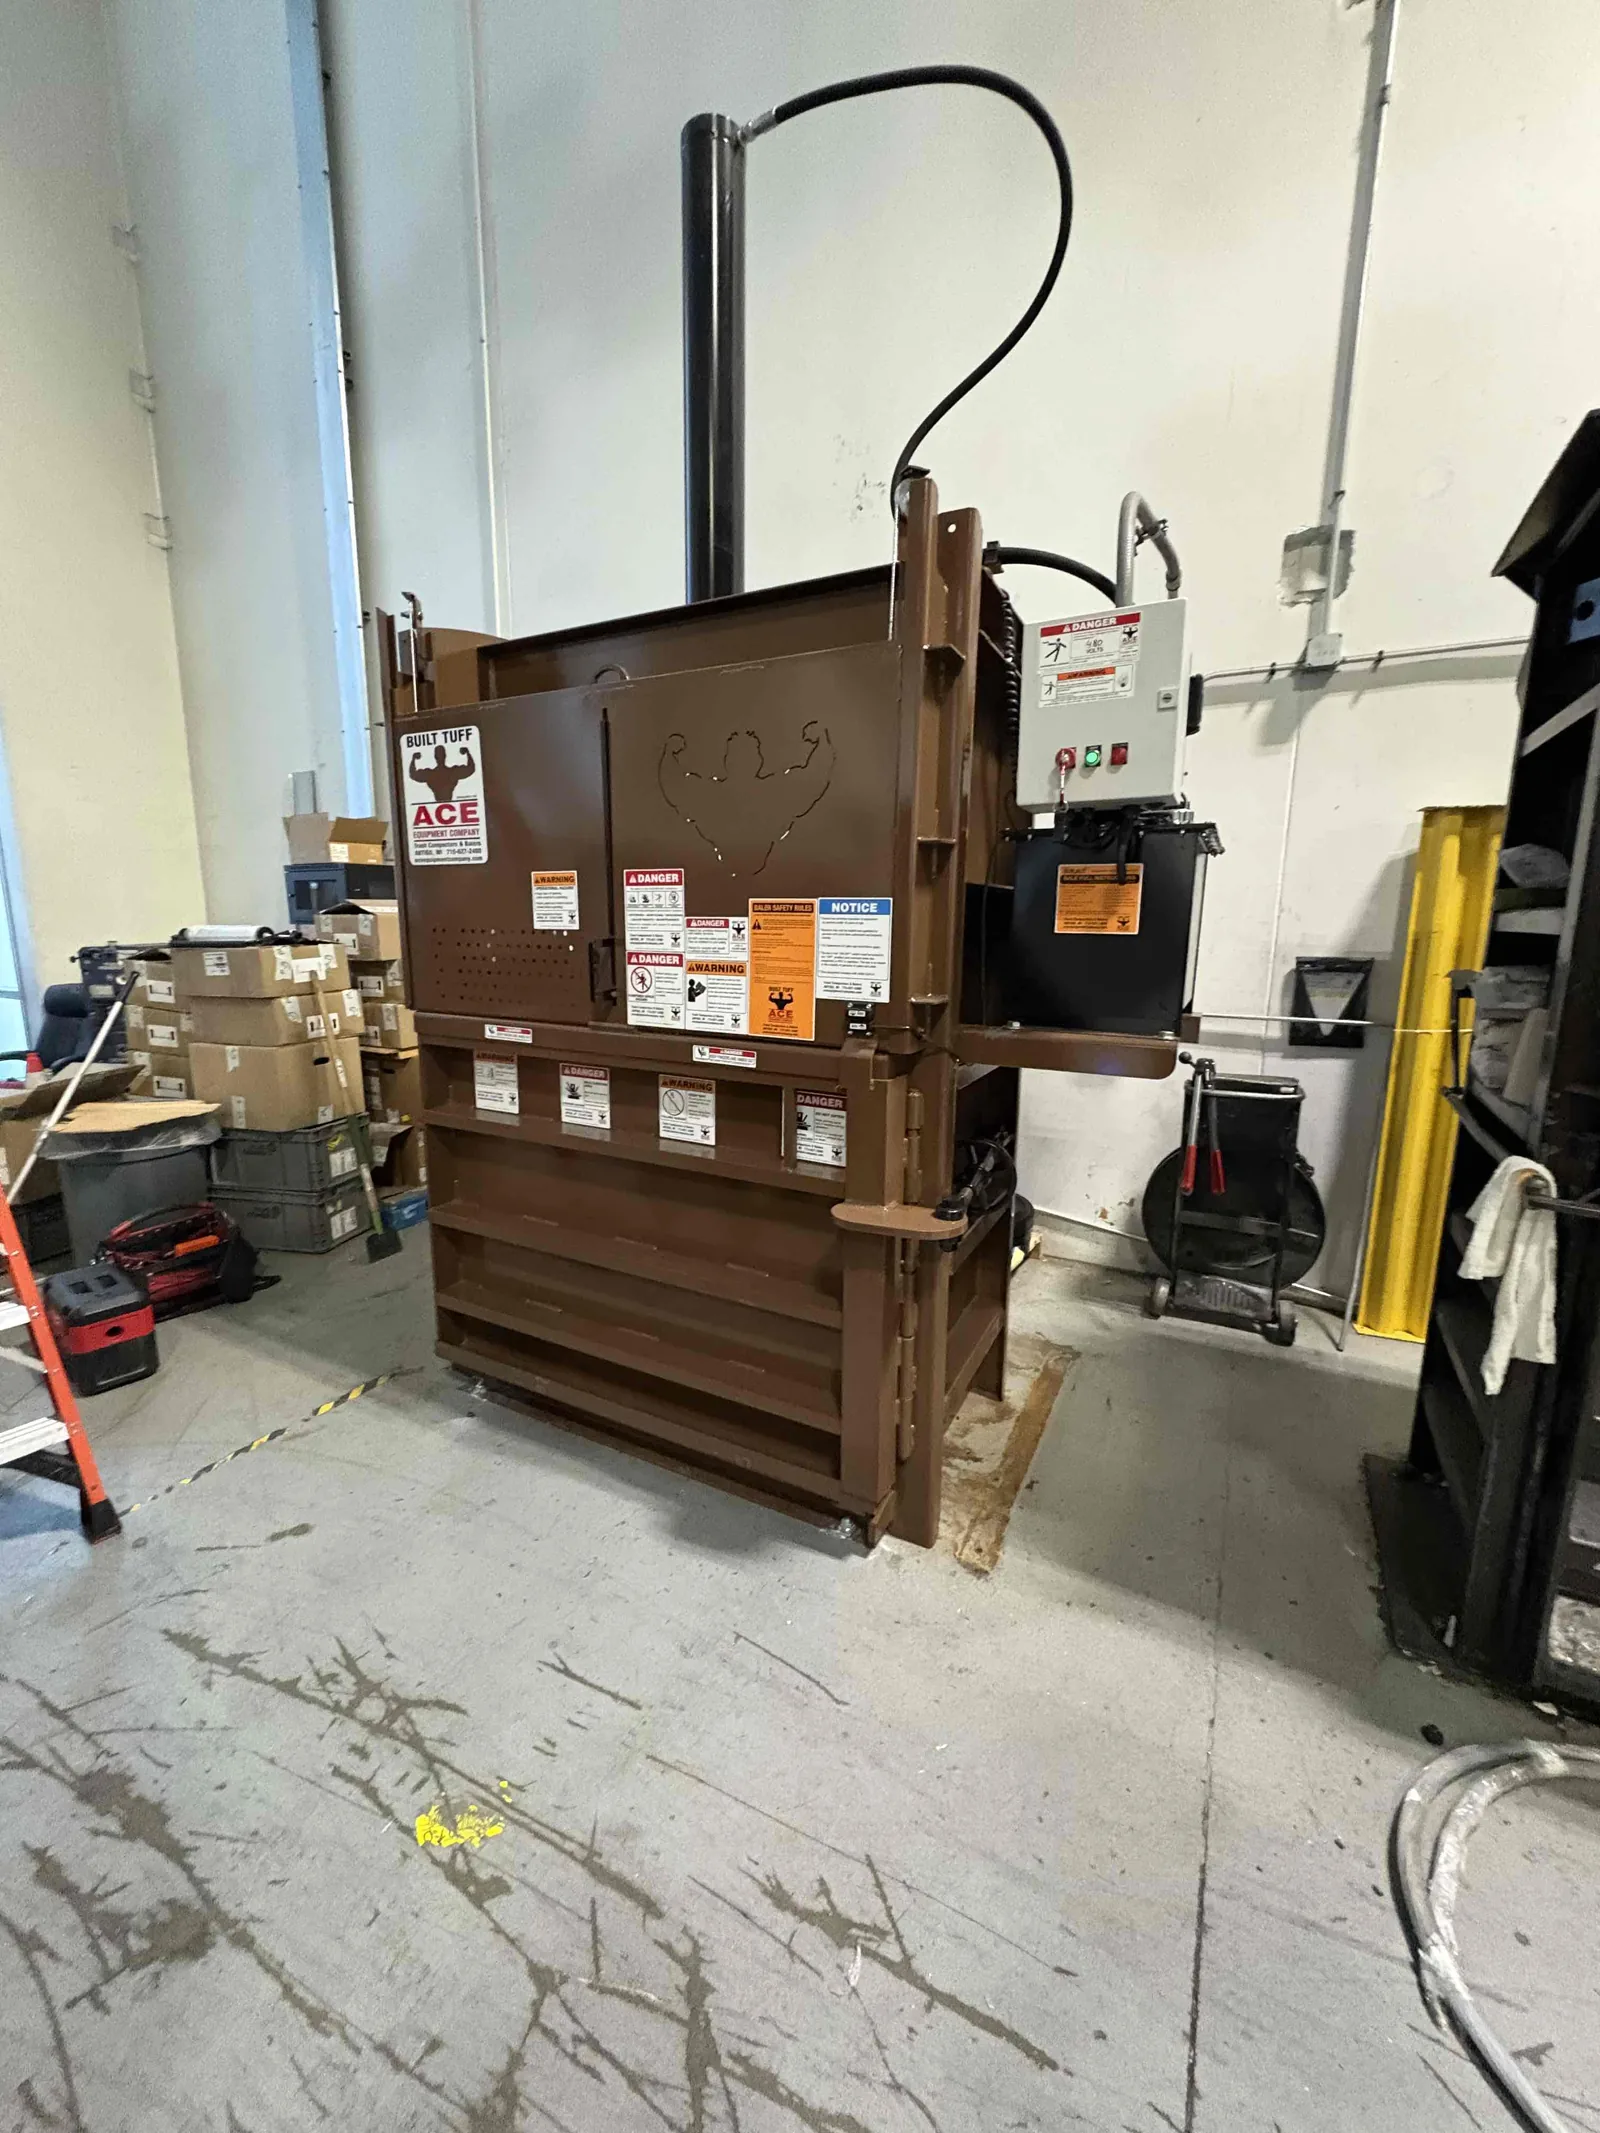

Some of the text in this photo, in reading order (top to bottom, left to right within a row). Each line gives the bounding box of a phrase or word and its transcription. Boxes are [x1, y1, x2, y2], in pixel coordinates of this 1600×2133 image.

[1072, 618, 1117, 631] DANGER
[406, 728, 473, 748] BUILT TUFF
[413, 802, 480, 826] ACE
[413, 828, 480, 839] EQUIPMENT COMPANY
[540, 875, 575, 883] WARNING
[637, 873, 679, 883] DANGER
[831, 902, 878, 913] NOTICE
[697, 919, 725, 927] DANGER
[638, 954, 680, 965] DANGER
[695, 963, 745, 974] WARNING
[768, 1009, 793, 1018] ACE
[570, 1067, 605, 1079] DANGER
[668, 1080, 713, 1092] WARNING
[797, 1094, 844, 1109] DANGER
